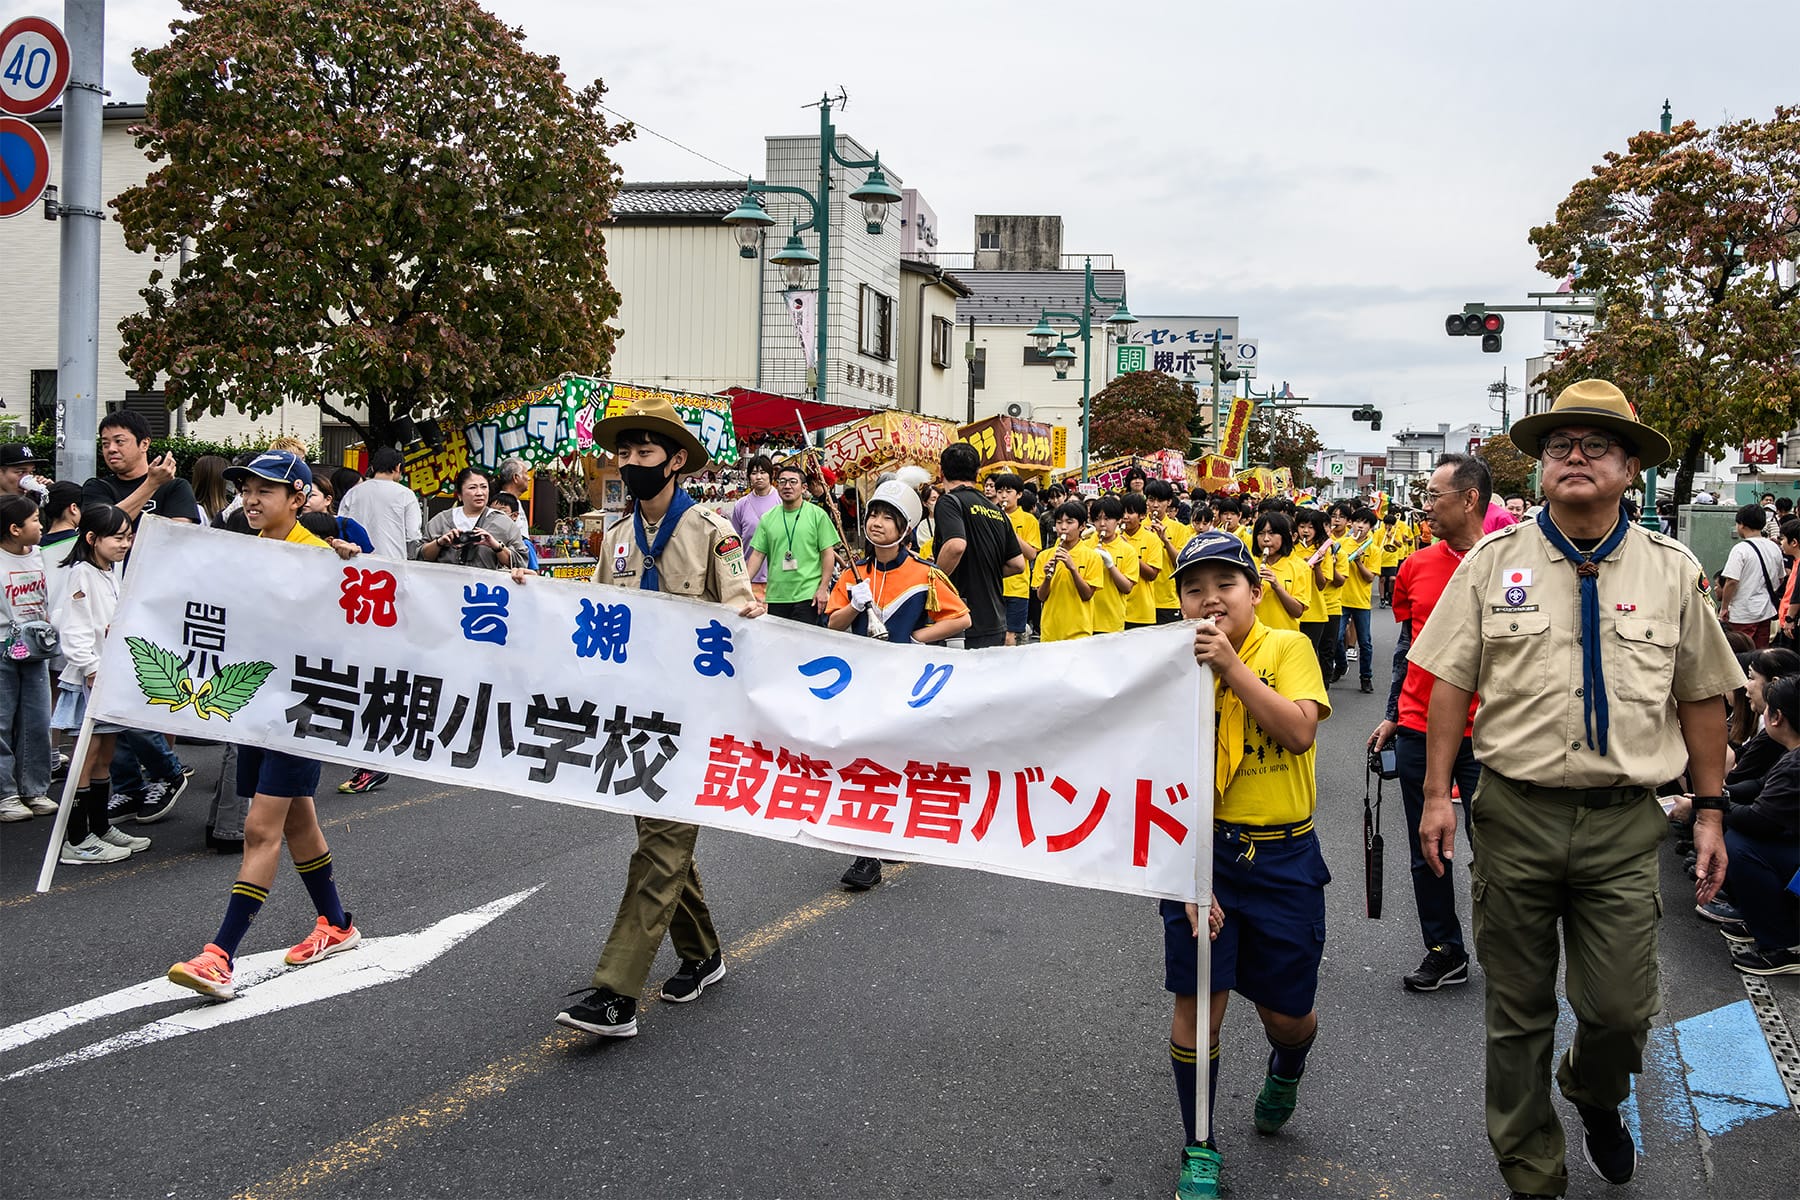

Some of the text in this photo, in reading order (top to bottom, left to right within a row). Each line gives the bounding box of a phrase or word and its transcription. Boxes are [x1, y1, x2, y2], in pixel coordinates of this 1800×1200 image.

[3, 44, 51, 89] 40
[1144, 329, 1233, 345] セレモニー
[825, 425, 882, 471] ポテト
[731, 560, 743, 575] 21
[339, 566, 954, 708] 祝 岩槻まつり
[285, 654, 1190, 868] 岩槻小学校 鼓笛金管バンド
